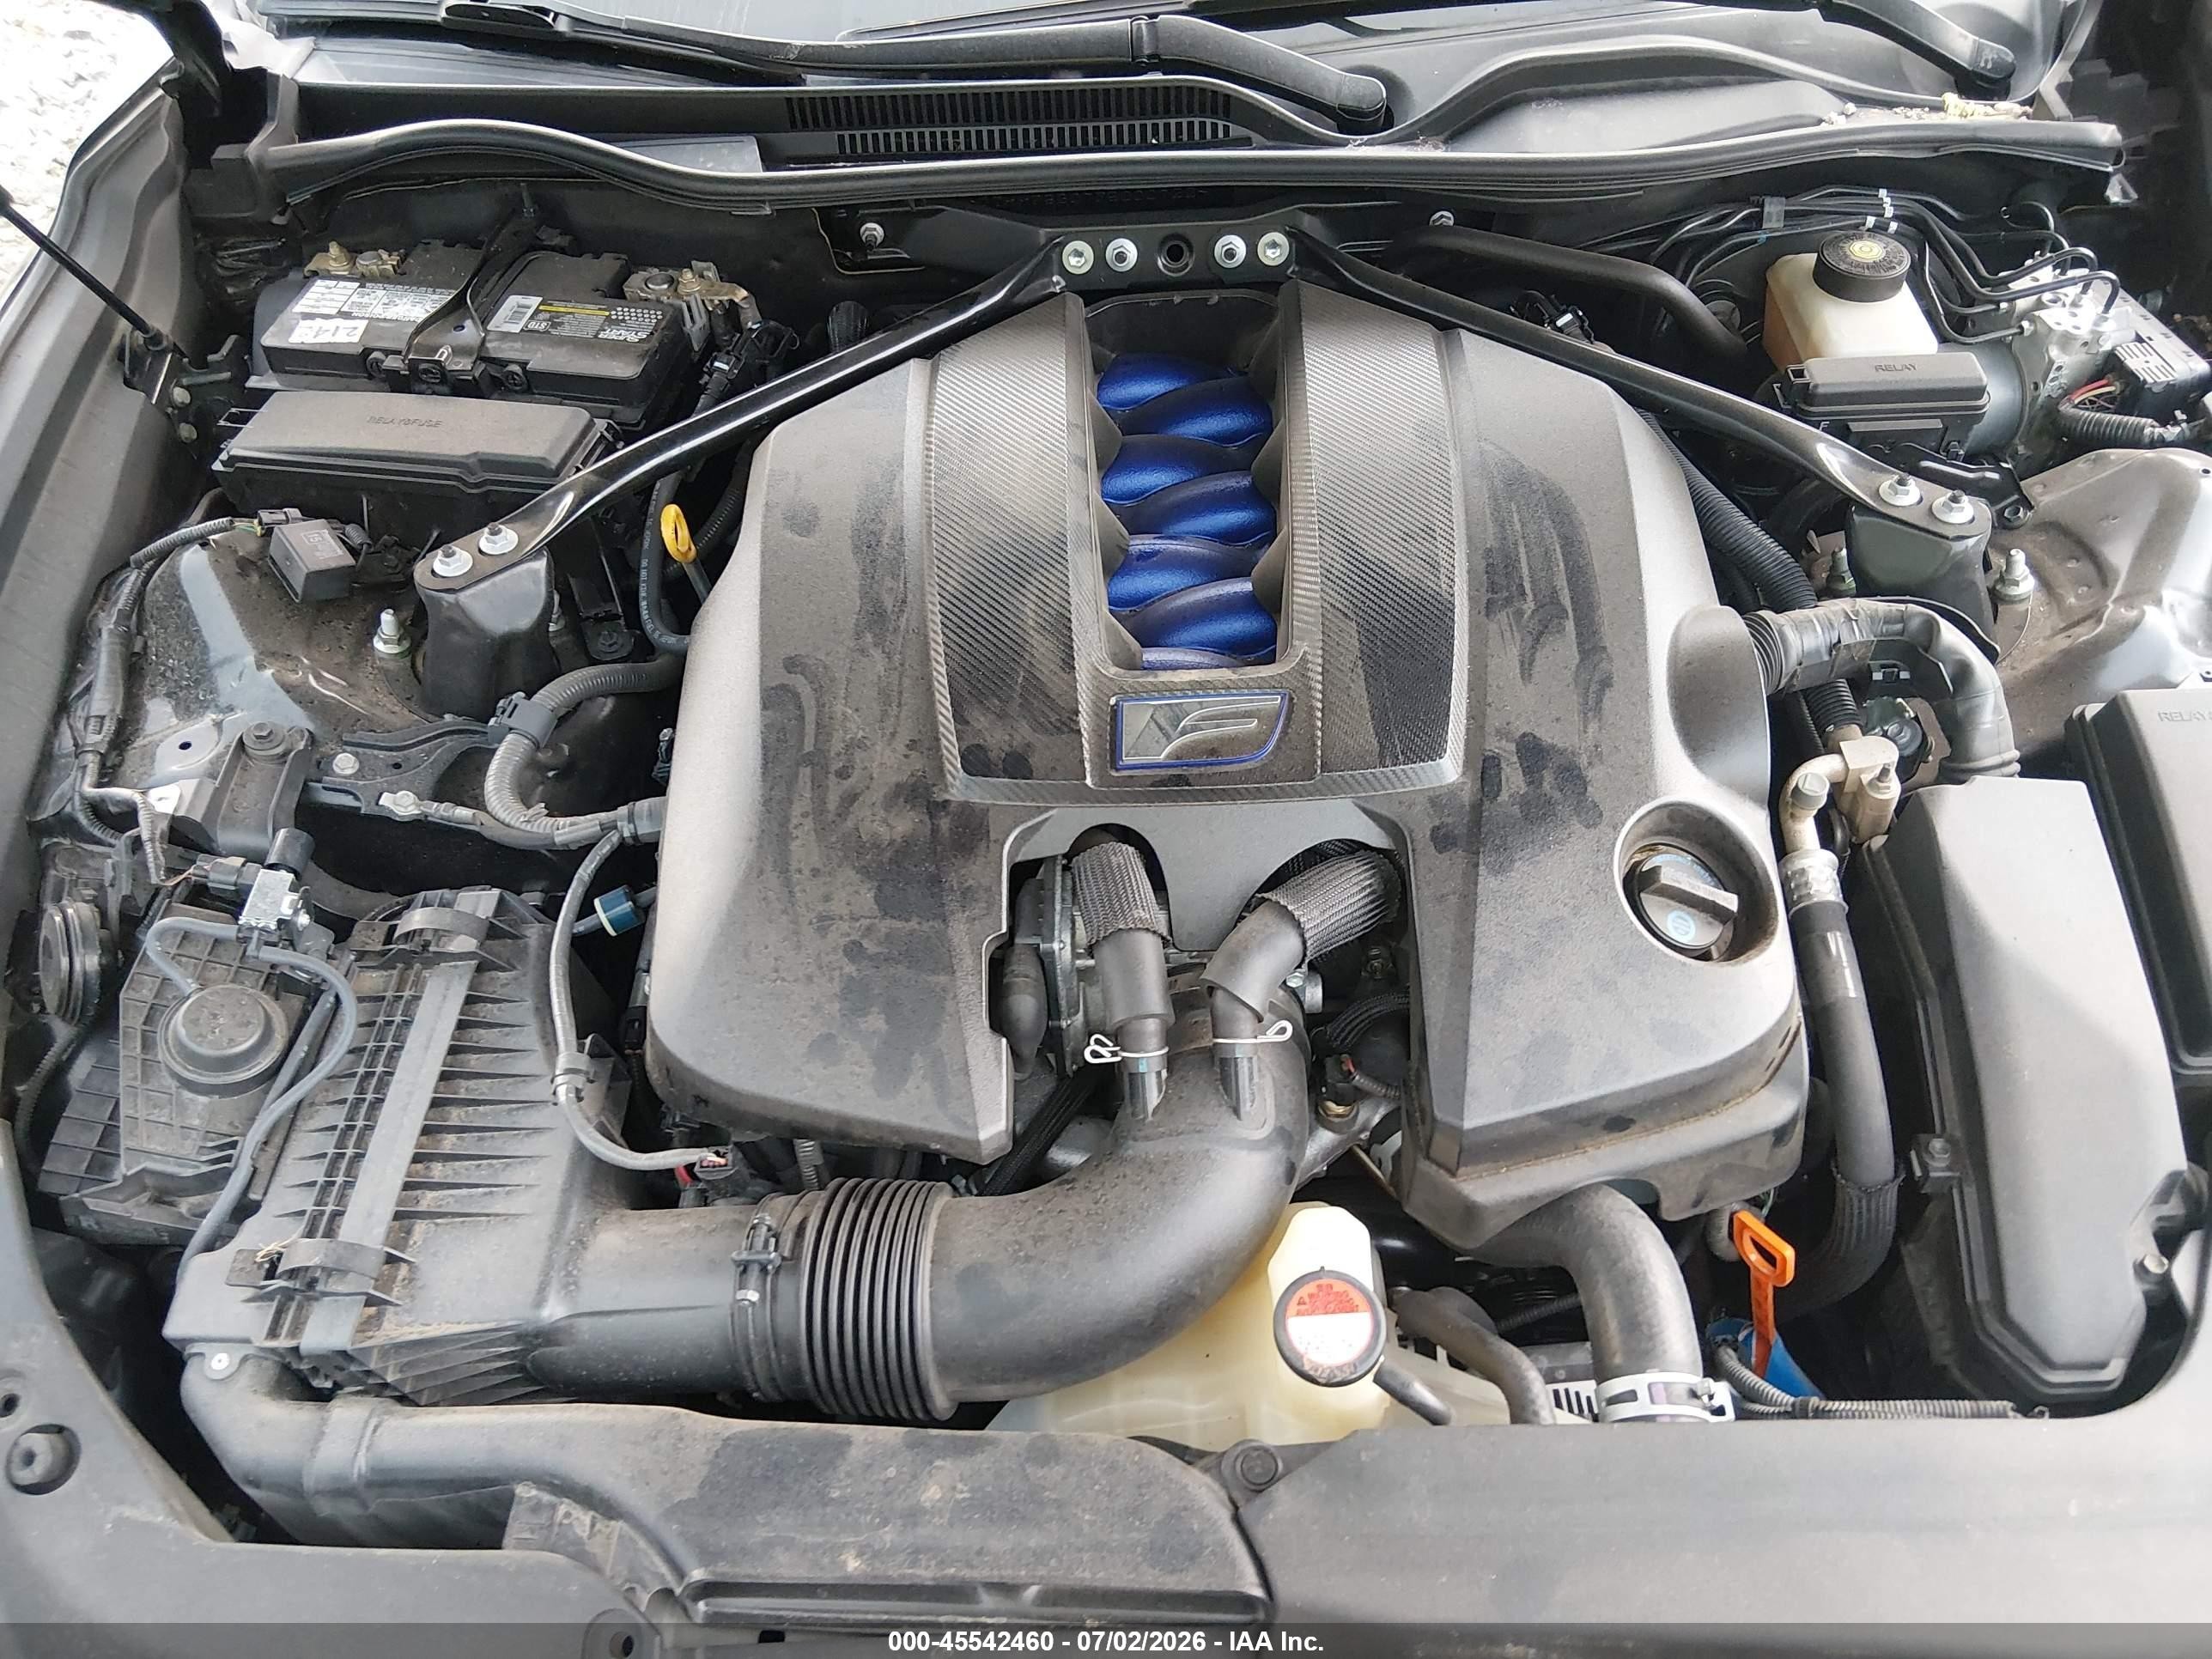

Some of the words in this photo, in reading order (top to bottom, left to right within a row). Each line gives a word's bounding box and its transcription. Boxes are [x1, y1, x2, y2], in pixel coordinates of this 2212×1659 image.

[598, 332, 640, 343] SUPER
[603, 327, 651, 339] START
[1875, 363, 1917, 372] RELAY
